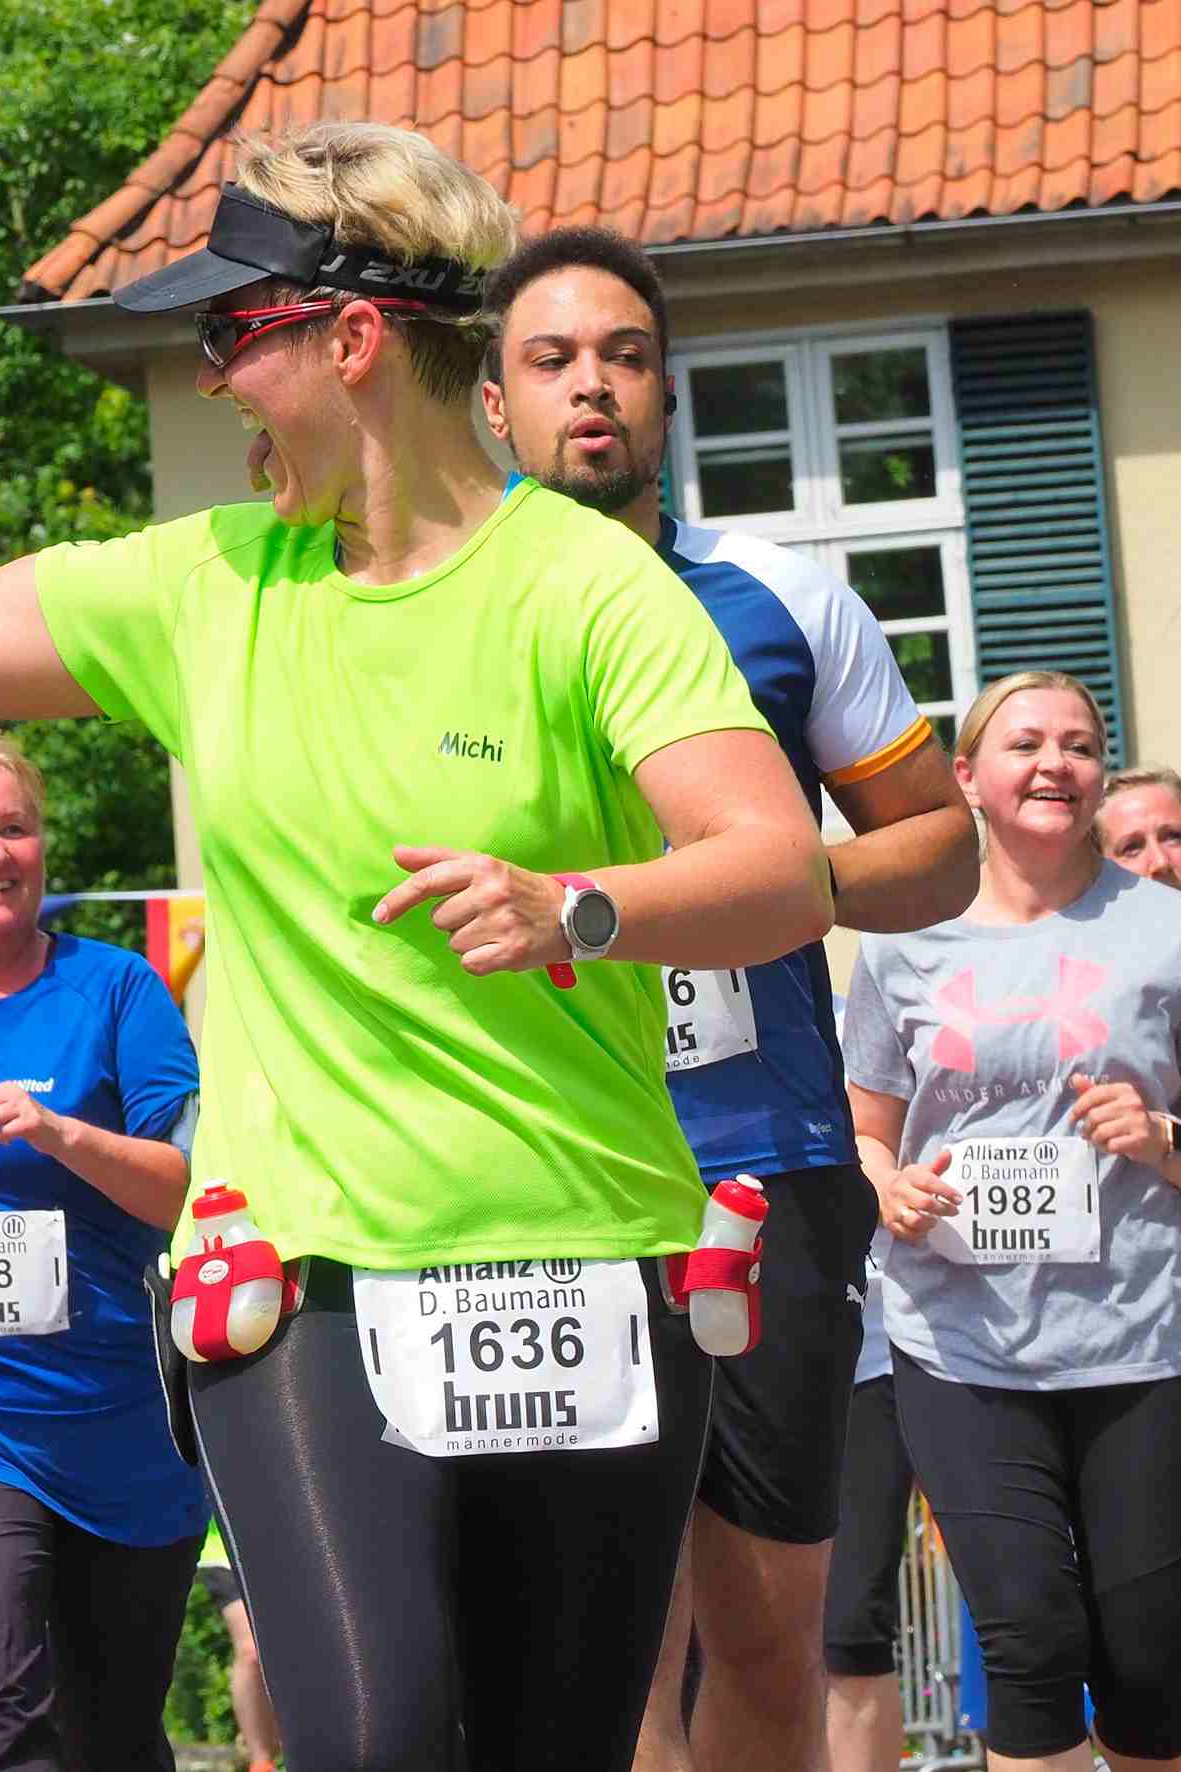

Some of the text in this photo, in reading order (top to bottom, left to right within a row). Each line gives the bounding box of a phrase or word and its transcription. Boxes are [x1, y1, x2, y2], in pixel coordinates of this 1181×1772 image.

[437, 731, 503, 762] Michi
[934, 1081, 1005, 1103] UNDER
[963, 1145, 1029, 1161] Allianz
[961, 1165, 1059, 1181] D. Baumann
[966, 1185, 1057, 1215] 1982
[973, 1220, 1050, 1249] bruns
[419, 1287, 587, 1317] D. Baumann
[430, 1316, 585, 1374] 1636
[443, 1380, 578, 1433] bruns
